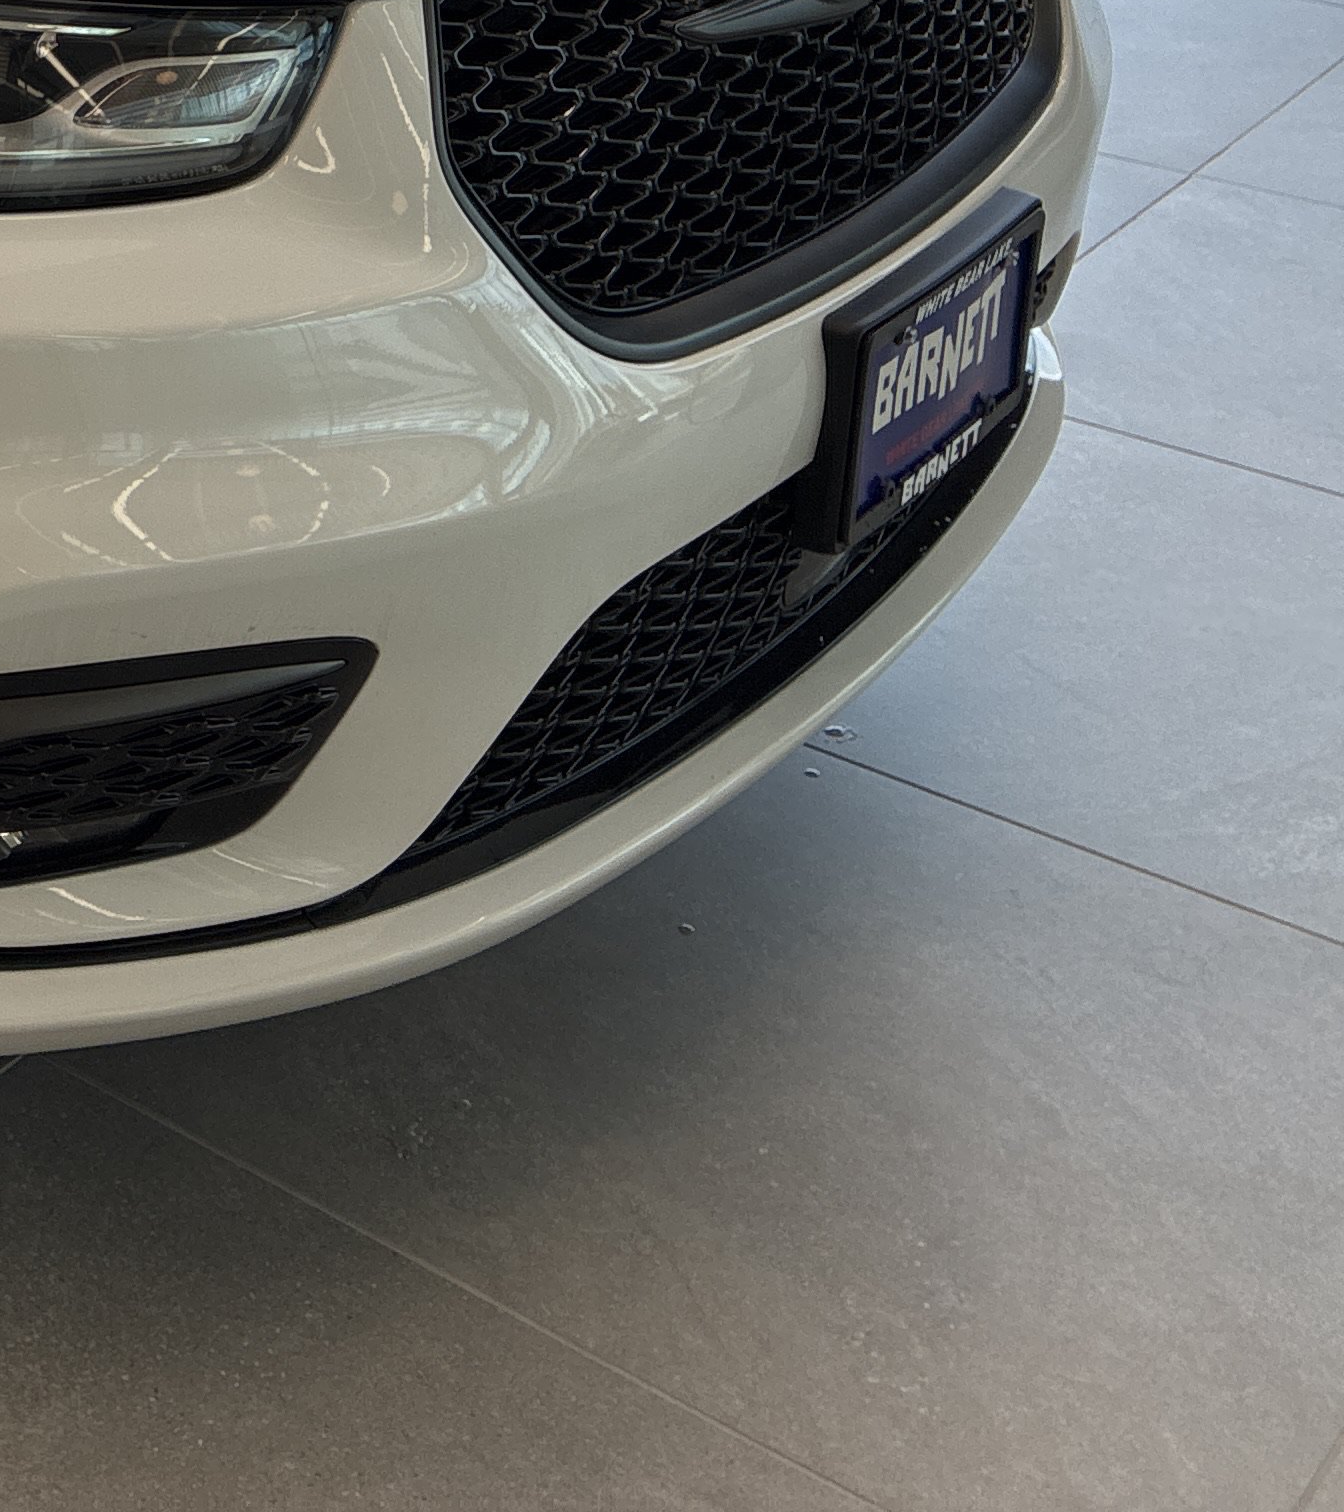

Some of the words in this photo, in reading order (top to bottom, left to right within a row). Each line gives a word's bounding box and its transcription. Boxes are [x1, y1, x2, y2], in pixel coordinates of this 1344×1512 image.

[915, 282, 955, 326] WHITE
[953, 259, 986, 299] BEAR
[872, 268, 1007, 436] BARNETT
[900, 417, 983, 506] BARNETT
